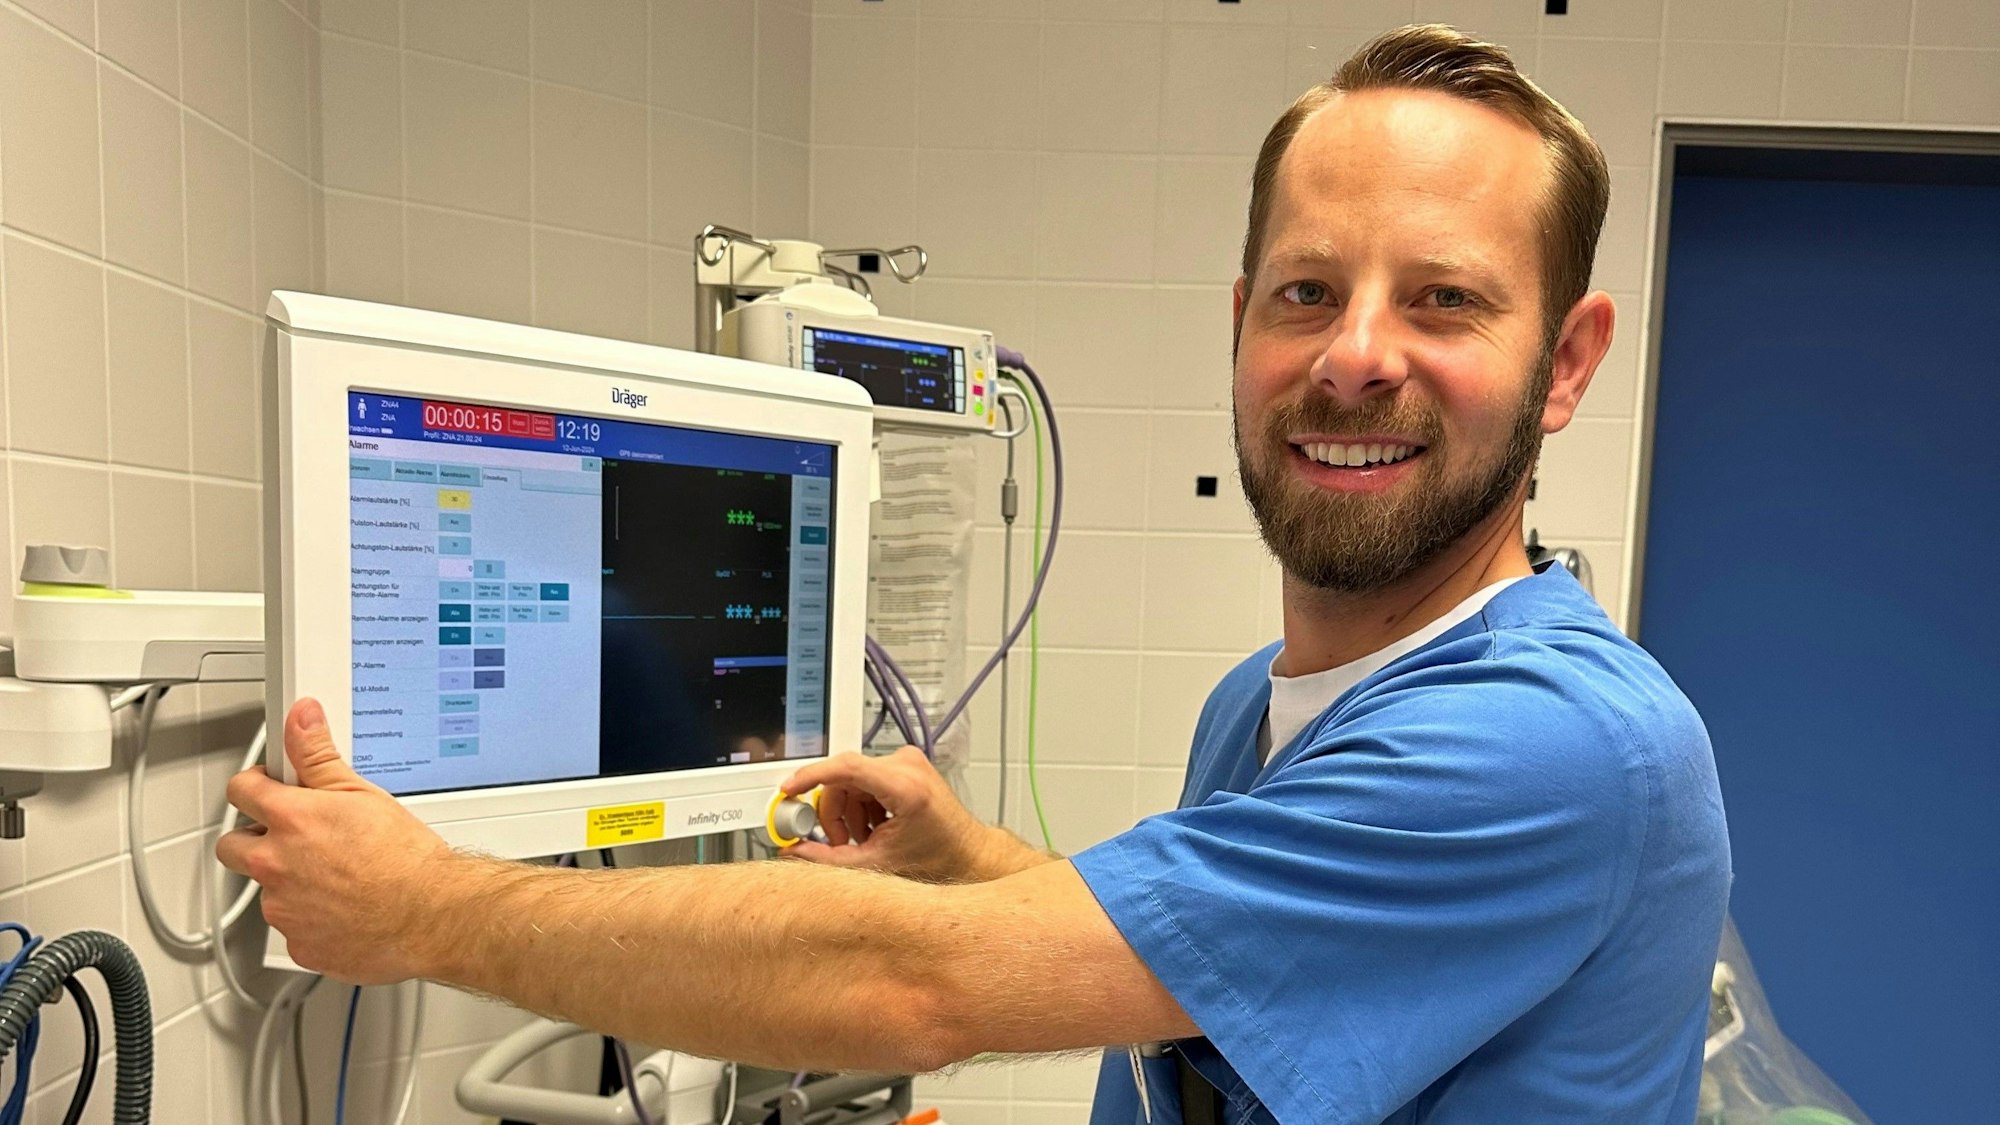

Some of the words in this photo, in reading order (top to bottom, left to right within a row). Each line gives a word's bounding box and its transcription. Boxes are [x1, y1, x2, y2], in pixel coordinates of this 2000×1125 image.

[380, 400, 400, 409] ZNA4
[612, 387, 648, 409] Dräger
[380, 413, 397, 422] ZNA
[425, 405, 503, 433] 00:00:15
[441, 432, 456, 441] ZNA
[557, 419, 601, 442] 12:19
[349, 439, 379, 451] Alarme
[687, 811, 721, 826] Infinity
[721, 808, 743, 822] C500
